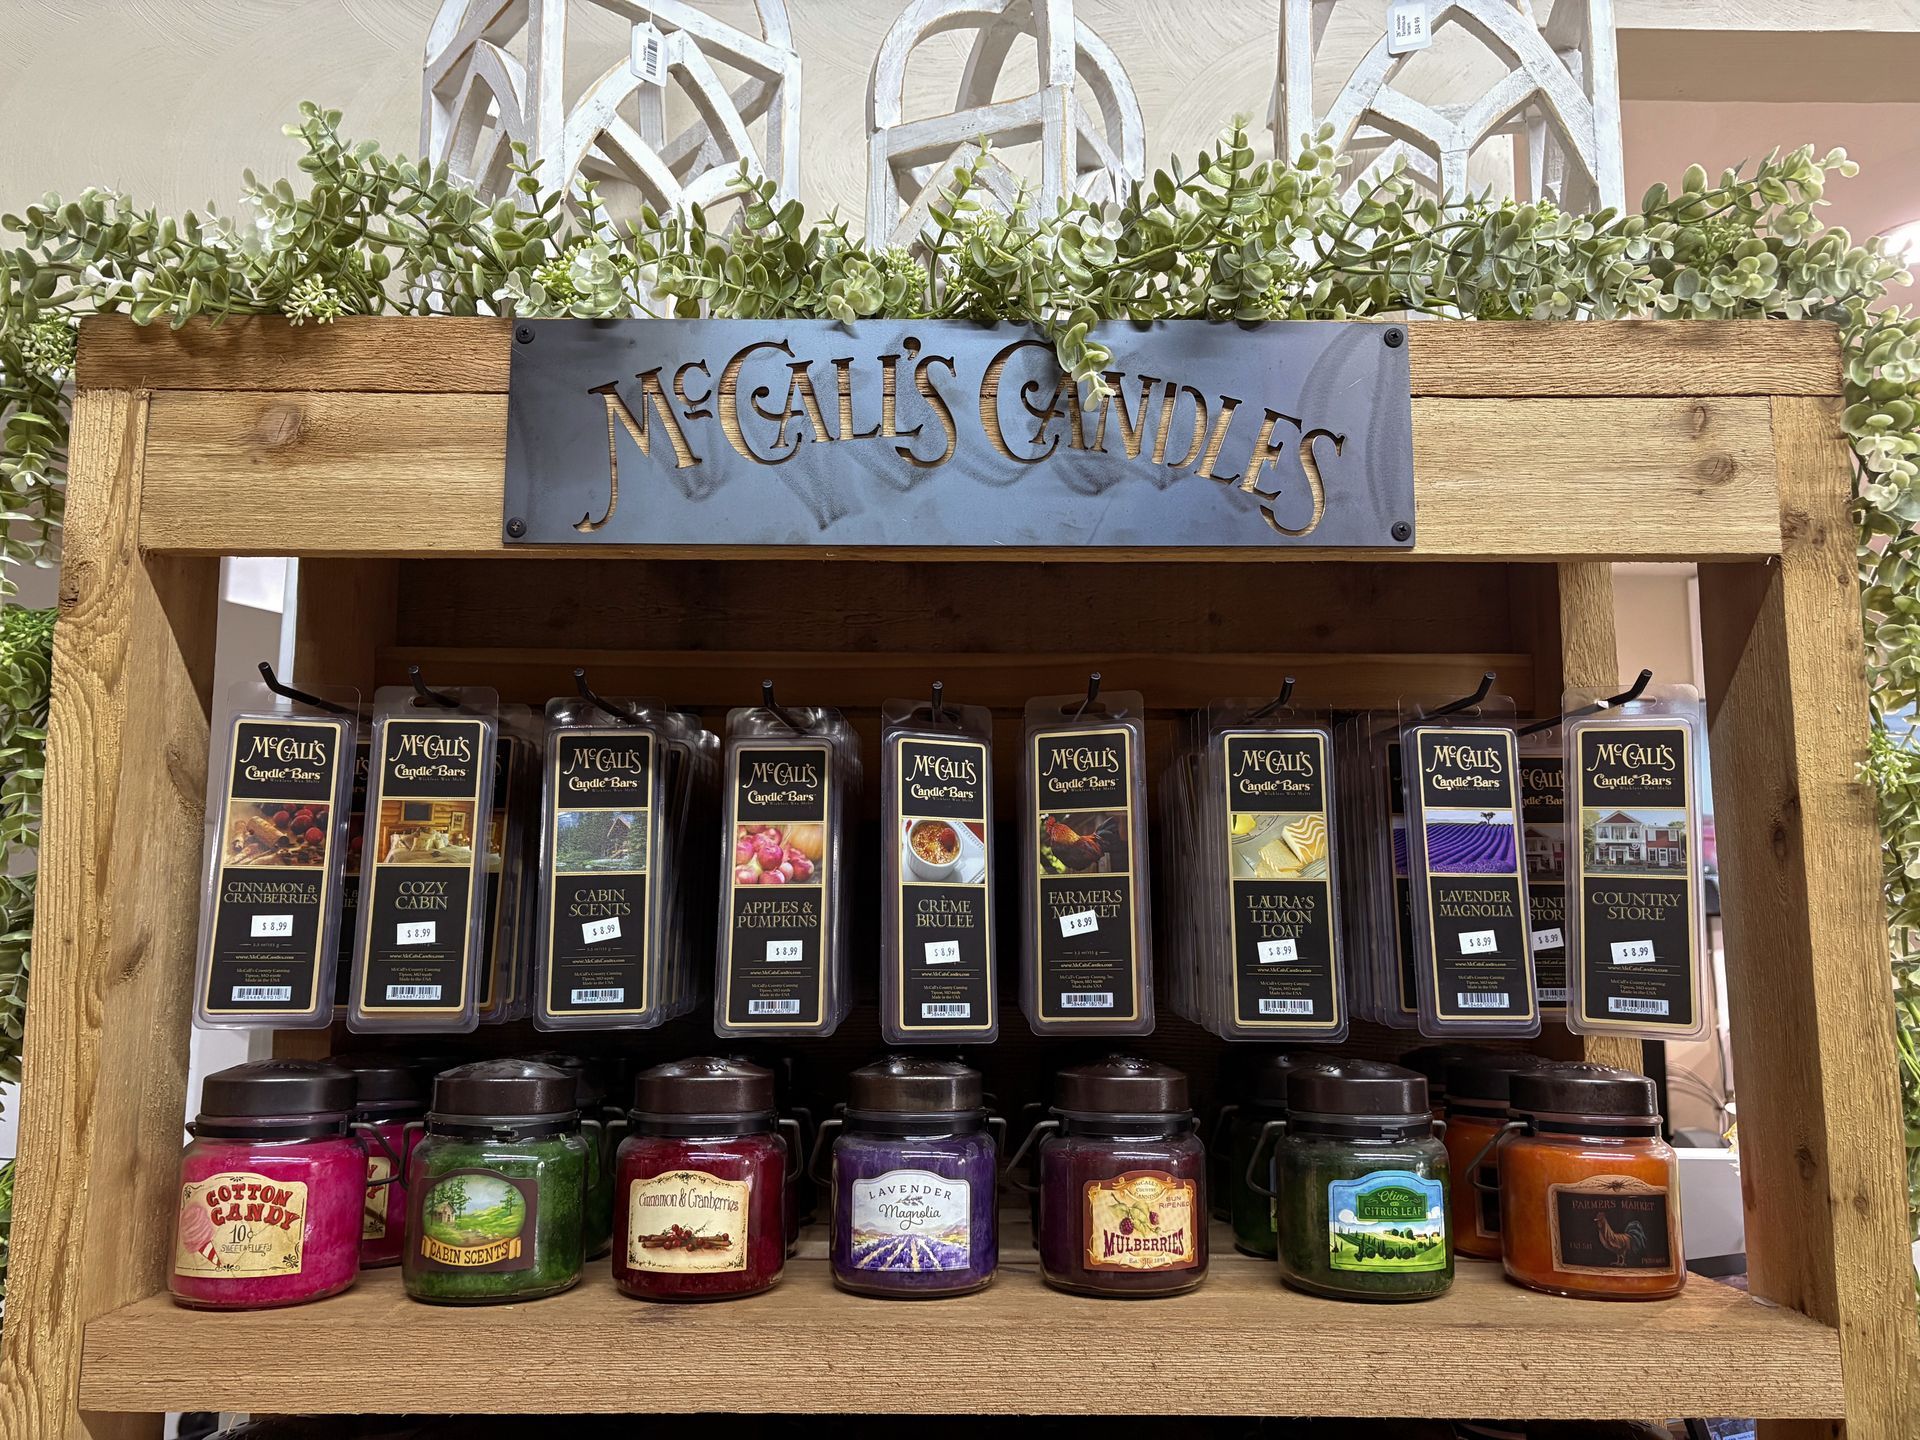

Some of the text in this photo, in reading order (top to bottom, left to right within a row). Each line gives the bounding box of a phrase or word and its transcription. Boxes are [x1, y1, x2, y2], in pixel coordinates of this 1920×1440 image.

[979, 339, 1349, 538] CANDLES
[245, 765, 321, 782] Candle Bars
[394, 763, 466, 780] Candle Bars
[568, 776, 638, 792] Candle Bars
[1048, 777, 1084, 793] Candle
[1083, 776, 1116, 788] Bars
[1239, 778, 1310, 795] Candle Bars
[1432, 774, 1469, 790] Candle
[1466, 775, 1500, 788] Bars
[1593, 773, 1672, 790] Candle Bars
[747, 789, 814, 805] Candle Bars
[910, 783, 974, 800] Candle Bars
[228, 881, 316, 894] CINNAMON &
[399, 881, 448, 896] COZY
[224, 892, 318, 904] CRANBERRIES
[574, 889, 625, 902] CABIN
[1048, 889, 1123, 905] FARMERS
[1247, 895, 1315, 909] LAURA'S
[1439, 890, 1512, 903] LAVENDER
[1592, 891, 1681, 907] COUNTRY
[395, 896, 448, 910] CABIN
[568, 902, 631, 917] SCENTS
[743, 901, 813, 914] APPLES &
[918, 895, 972, 914] CRÈME
[1250, 909, 1312, 924] LEMON
[1440, 904, 1514, 917] MAGNOLIA
[1530, 909, 1565, 920] STOR
[1607, 906, 1665, 920] STORE
[262, 922, 287, 931] $ 8.99
[737, 914, 818, 928] PUMPKINS
[916, 913, 975, 928] BRULEE
[1070, 917, 1092, 929] $ 8.99
[407, 928, 431, 938] $ 8.99
[592, 924, 615, 936] $ 8.99
[1260, 924, 1304, 938] LOAF
[1469, 936, 1491, 947] $ 8.99
[1545, 934, 1558, 943] 8.99
[775, 947, 798, 956] $ 8.99
[934, 947, 955, 957] $ 8.99
[1269, 945, 1292, 956] $ 8.99
[1623, 946, 1649, 957] $ 8.99
[206, 1183, 293, 1208] COTTON
[869, 1184, 952, 1200] LAVENDER
[1378, 1190, 1410, 1202] Olive
[639, 1187, 739, 1212] Cinnamon & Cranberries
[1572, 1200, 1656, 1212] FARMERS MARKET
[210, 1203, 300, 1231] CANDY
[879, 1203, 942, 1231] Magnolia
[1364, 1206, 1422, 1216] CITRUS LEAF
[1103, 1227, 1185, 1258] MULBERRIES
[430, 1241, 509, 1265] CABIN SCENTS
